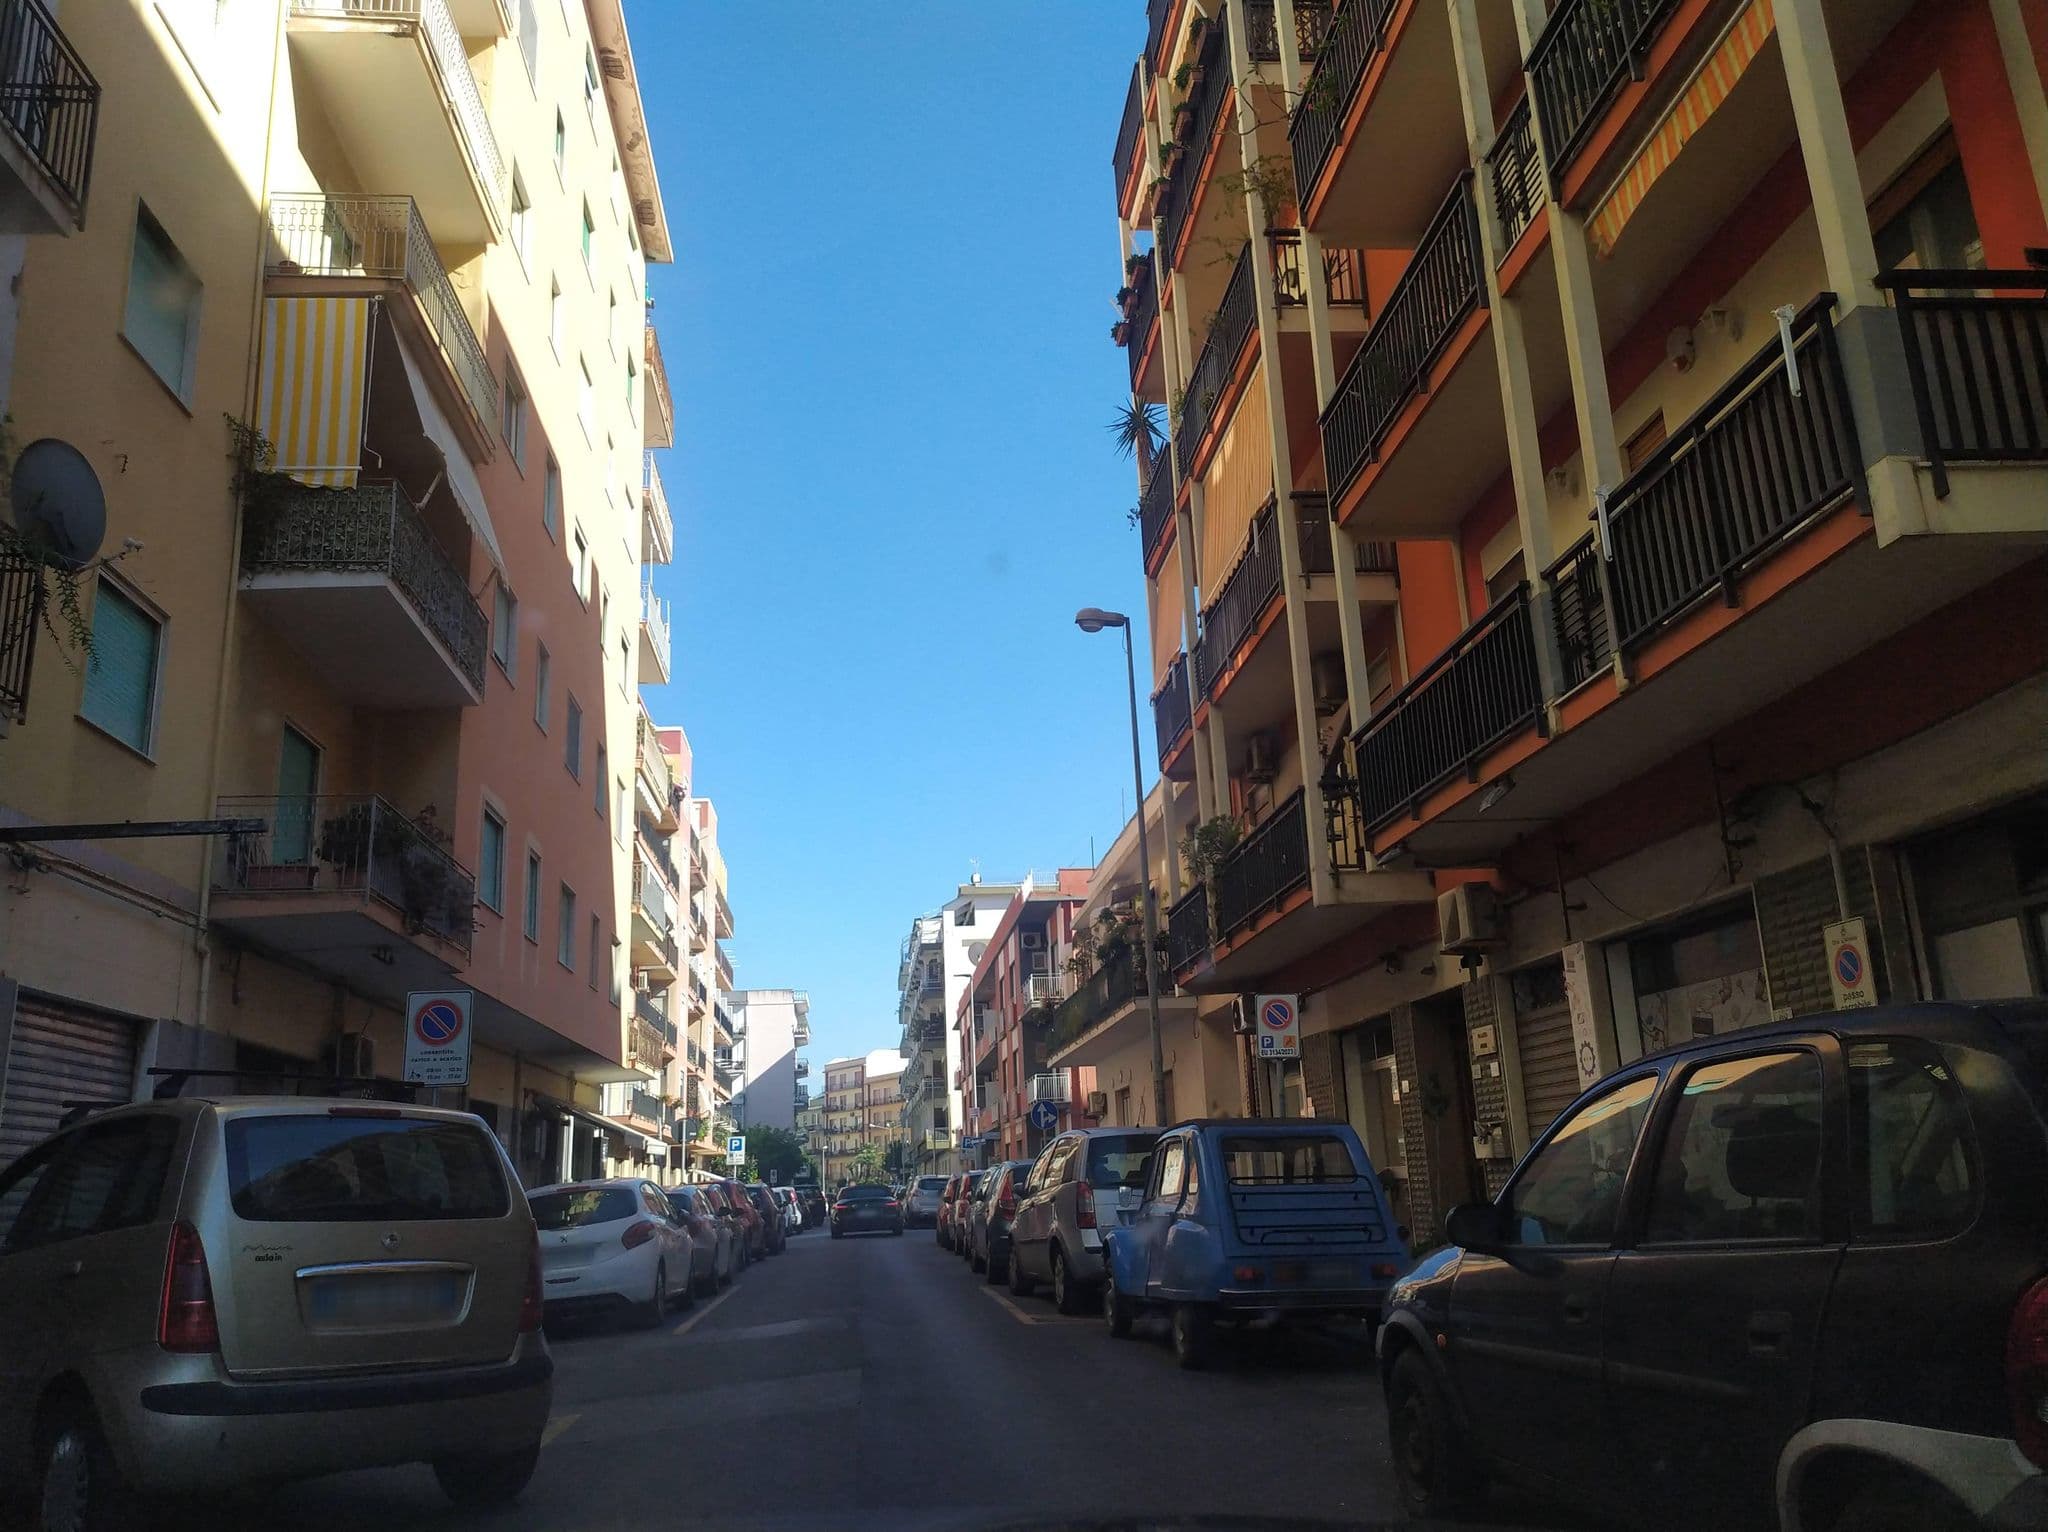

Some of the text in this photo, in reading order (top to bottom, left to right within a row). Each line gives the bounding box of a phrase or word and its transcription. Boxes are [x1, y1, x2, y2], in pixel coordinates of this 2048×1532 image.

[1843, 990, 1865, 1002] passo
[1263, 1037, 1271, 1047] P
[732, 1140, 740, 1150] P
